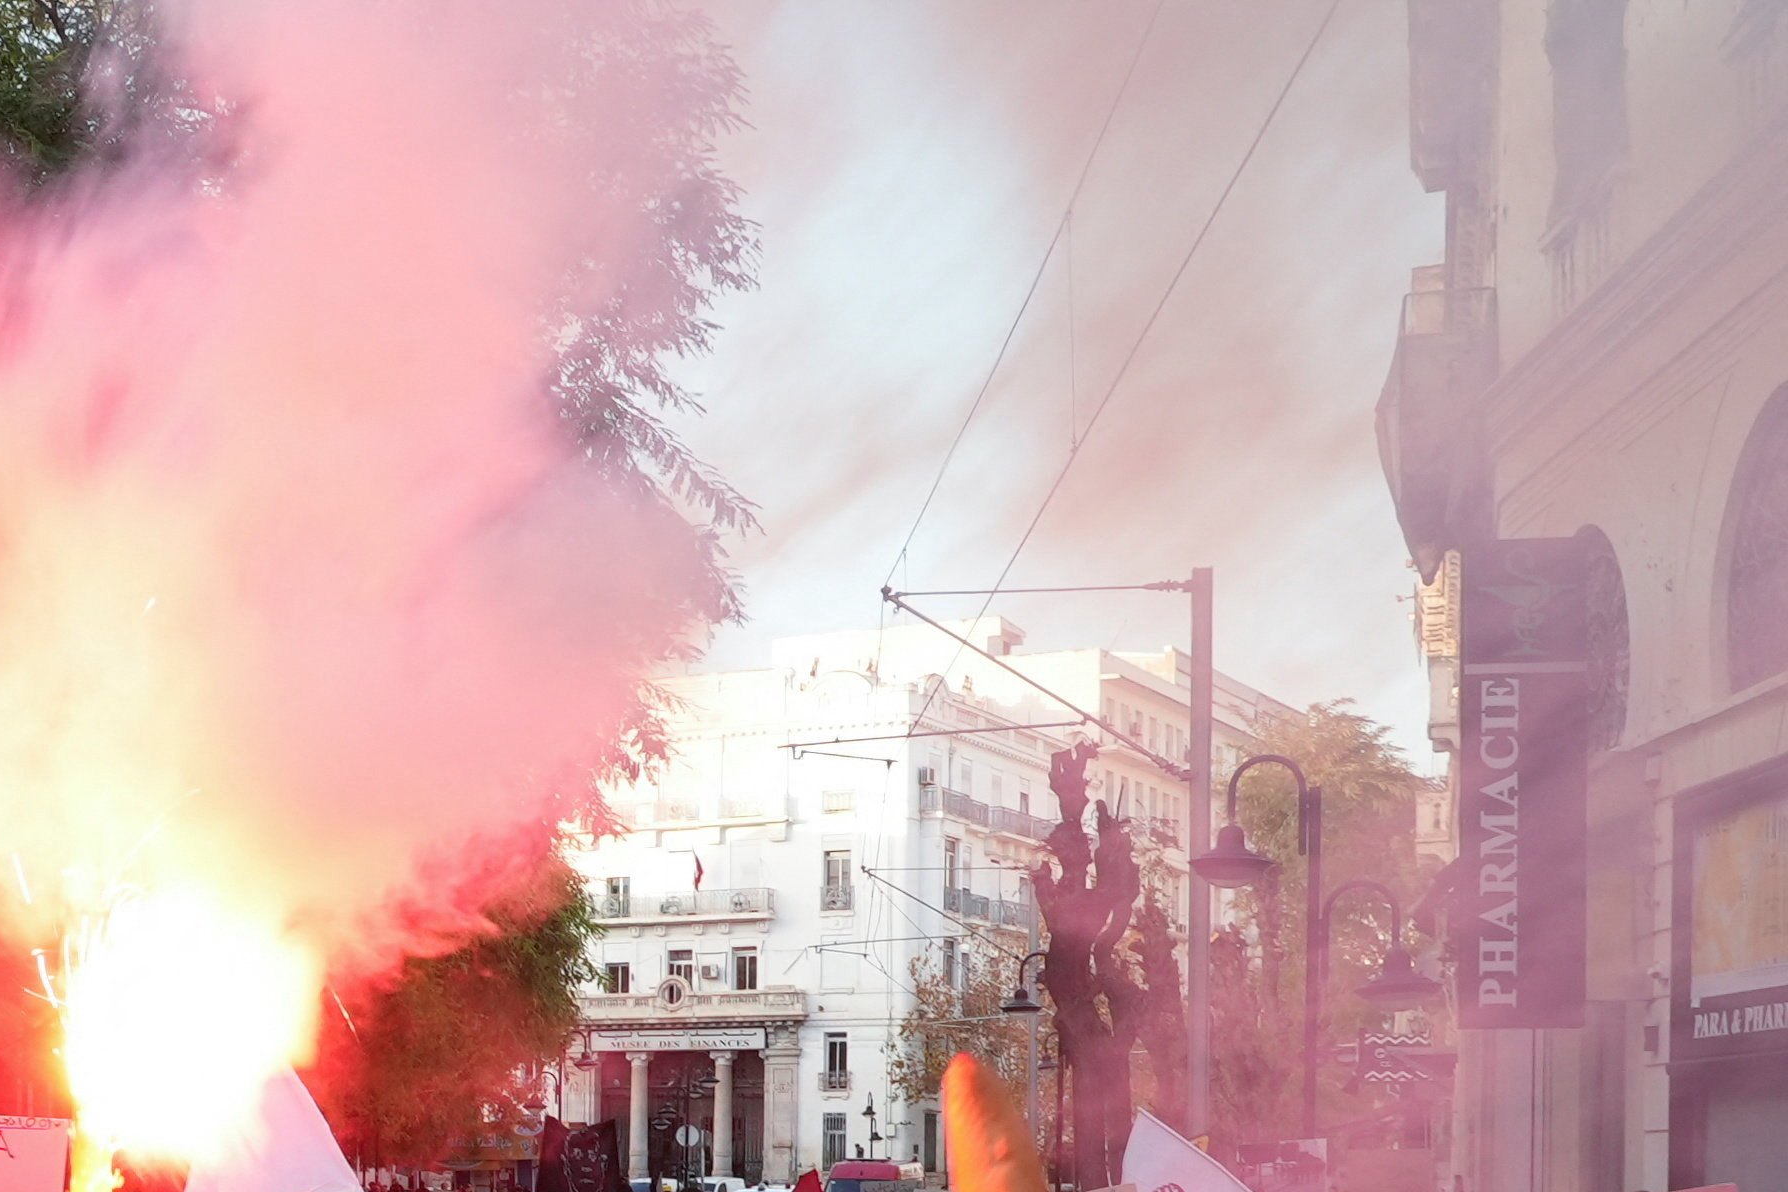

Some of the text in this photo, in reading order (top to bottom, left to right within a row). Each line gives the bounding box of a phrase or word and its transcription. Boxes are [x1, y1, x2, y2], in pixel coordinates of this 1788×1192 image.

[1477, 677, 1520, 1009] PHARMACIE
[1693, 1009, 1729, 1039] PARA
[1731, 1007, 1743, 1034] &
[659, 1040, 680, 1048] DES
[689, 1038, 751, 1048] FINANCES
